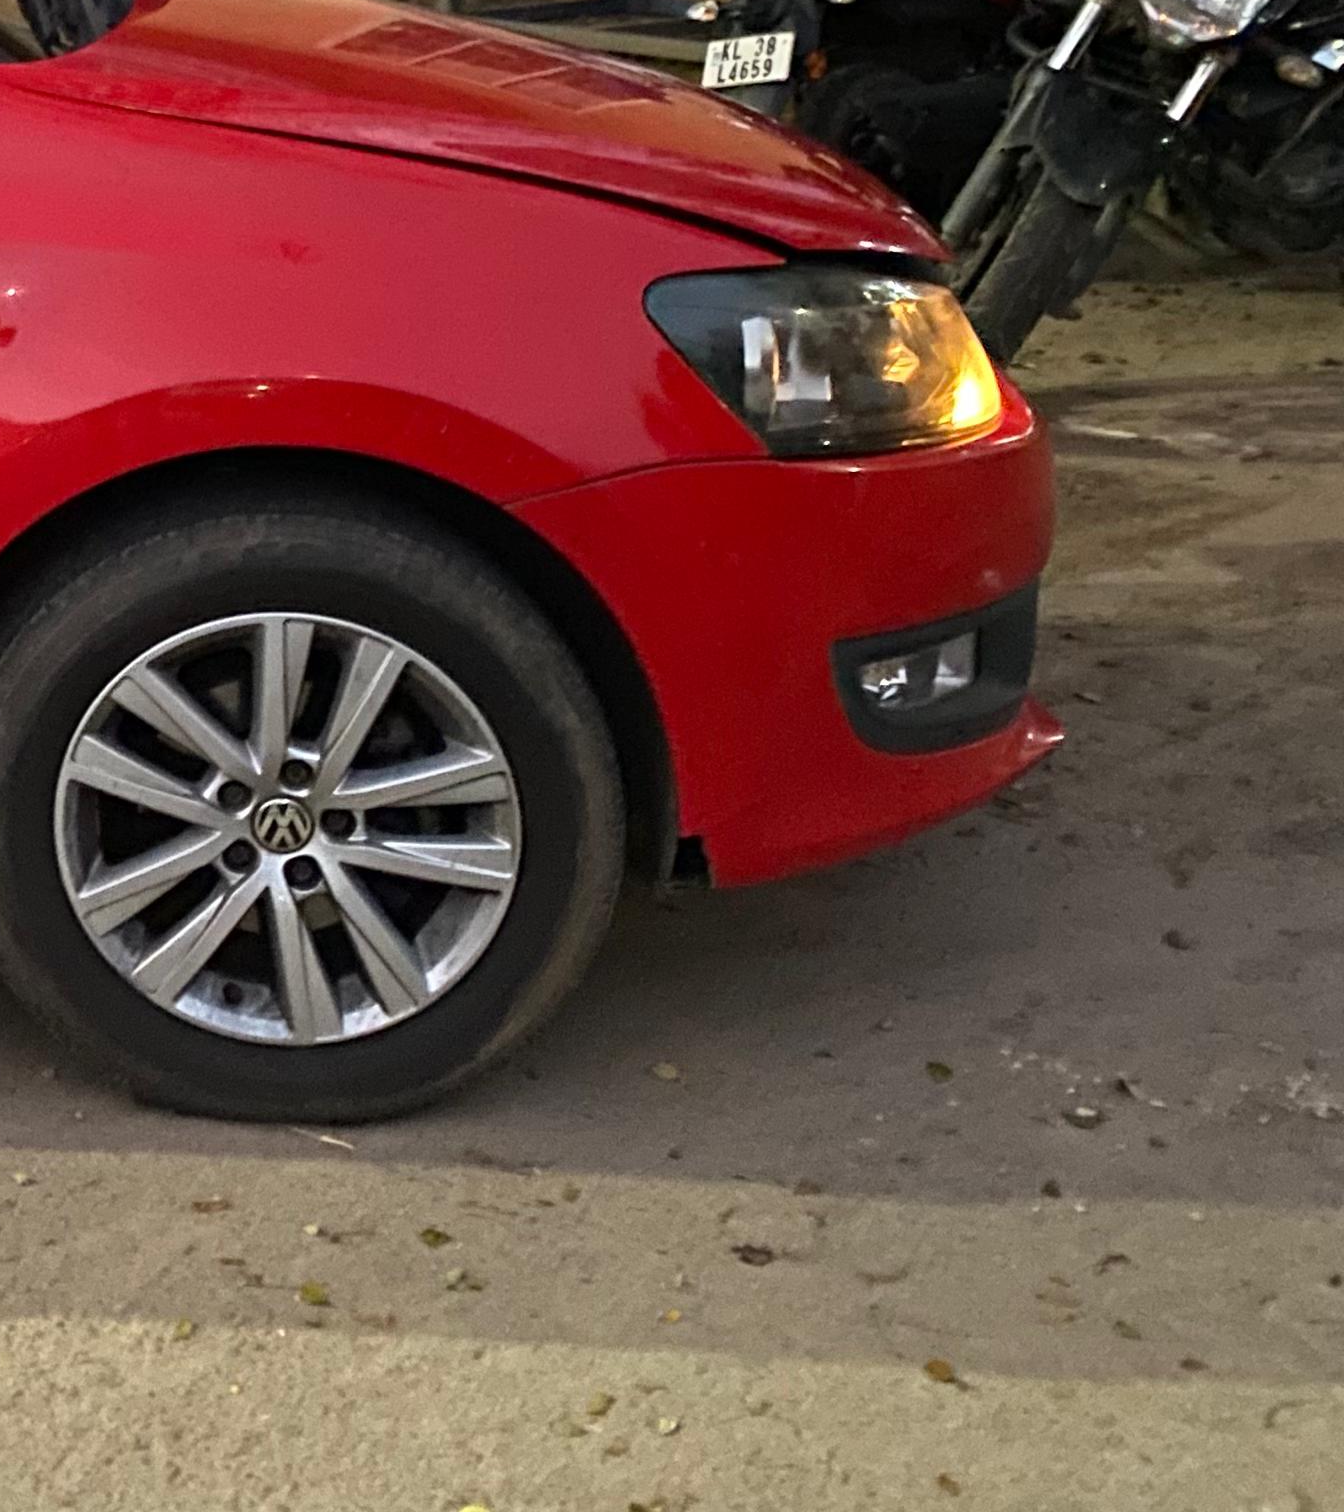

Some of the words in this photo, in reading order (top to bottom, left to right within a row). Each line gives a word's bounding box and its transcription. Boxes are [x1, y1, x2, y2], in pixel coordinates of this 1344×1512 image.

[721, 40, 742, 61] KL
[754, 36, 777, 57] 38
[717, 58, 773, 83] L4659
